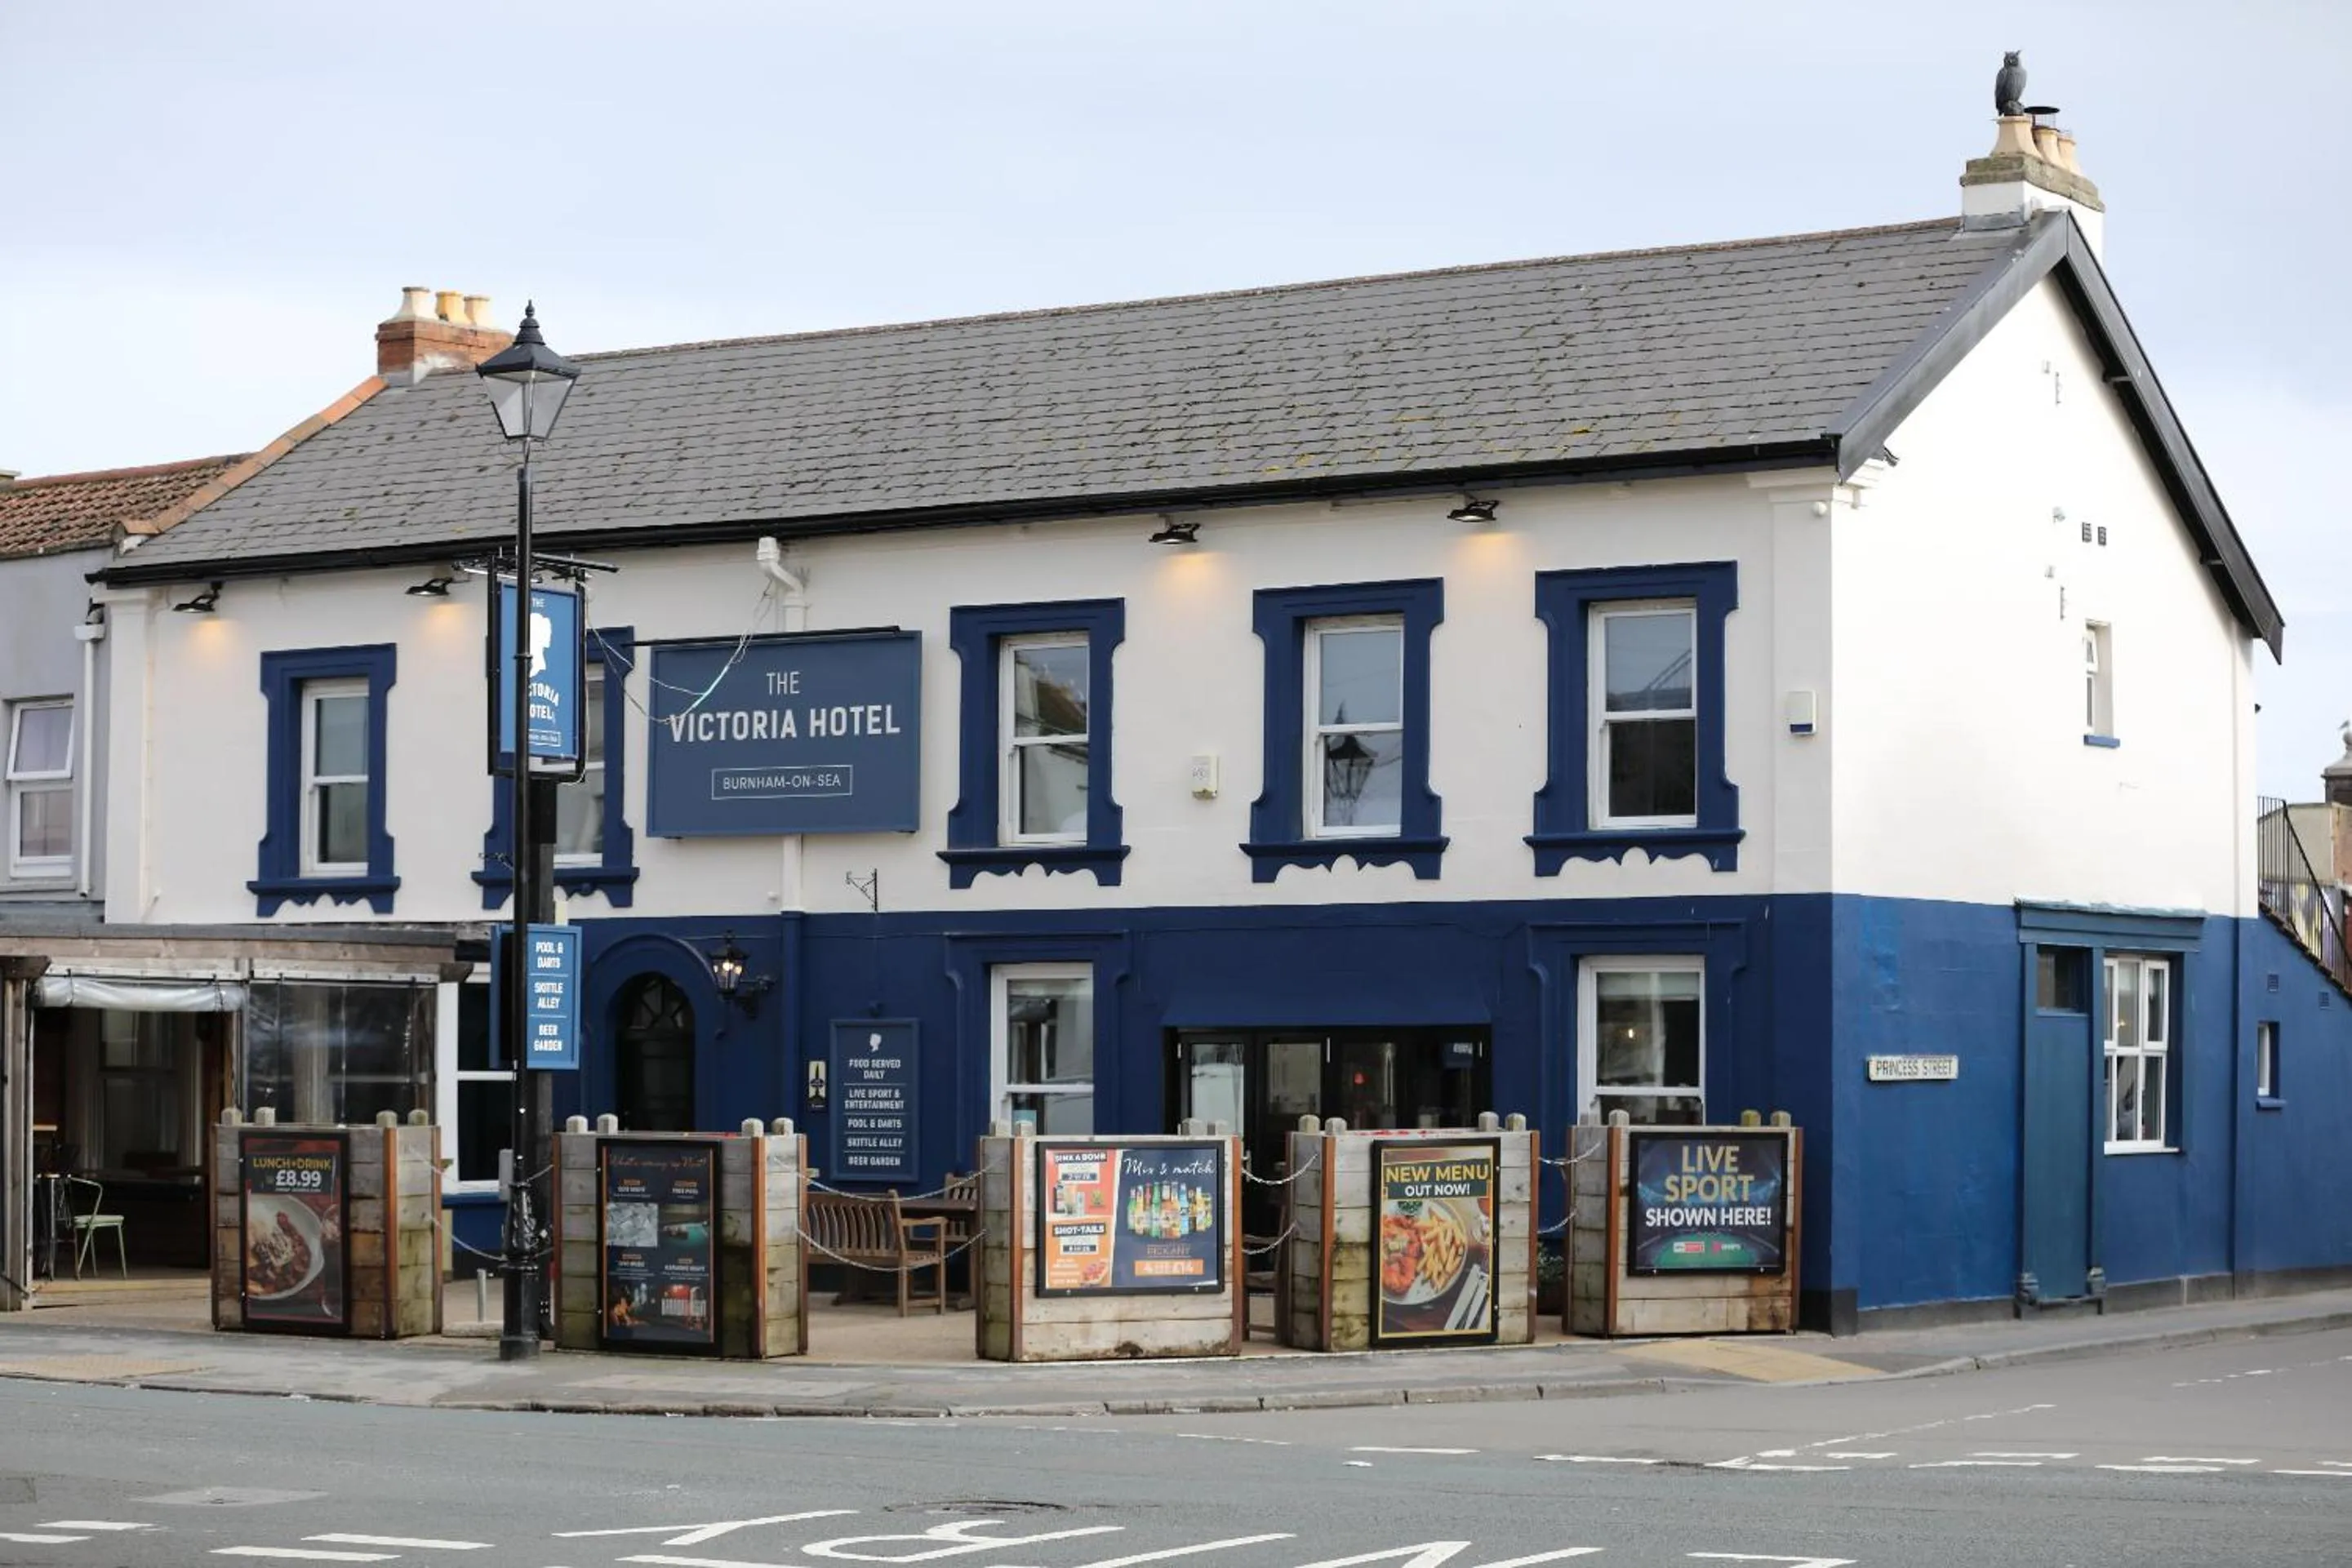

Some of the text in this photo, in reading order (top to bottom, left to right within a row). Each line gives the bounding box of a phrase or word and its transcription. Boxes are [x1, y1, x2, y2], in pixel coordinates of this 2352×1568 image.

[532, 597, 545, 607] THE
[767, 671, 801, 695] THE
[528, 682, 559, 708] TORIA
[530, 704, 553, 719] OTEL
[669, 704, 900, 742] VICTORIA HOTEL
[722, 774, 841, 790] BURNHAM-ON-SEA
[536, 942, 555, 953] POOL
[537, 957, 560, 969] DARTS
[534, 982, 563, 993] SKITTLE
[537, 997, 560, 1009] ALLEY
[539, 1024, 558, 1036] BEER
[534, 1041, 562, 1051] GARDEN
[849, 1059, 901, 1068] FOOD SERVED
[1876, 1060, 1952, 1076] PRINCESS STREET
[864, 1070, 885, 1080] DAILY
[849, 1089, 866, 1099] LIVE
[868, 1089, 891, 1099] SPORT
[845, 1100, 904, 1109] ENTERTAINMENT
[847, 1119, 902, 1128] POOL & DARTS
[847, 1138, 902, 1147] SKITTLE ALLEY
[848, 1156, 900, 1166] BEER GARDEN
[1682, 1145, 1740, 1173] LIVE
[1123, 1157, 1154, 1175] Mix
[1172, 1159, 1215, 1175] match
[276, 1170, 322, 1188] £8.99
[1385, 1165, 1488, 1183] NEW MENU
[1404, 1184, 1470, 1197] OUT NOW!
[1664, 1175, 1754, 1202] SPORT
[1646, 1207, 1772, 1227] SHOWN HERE!
